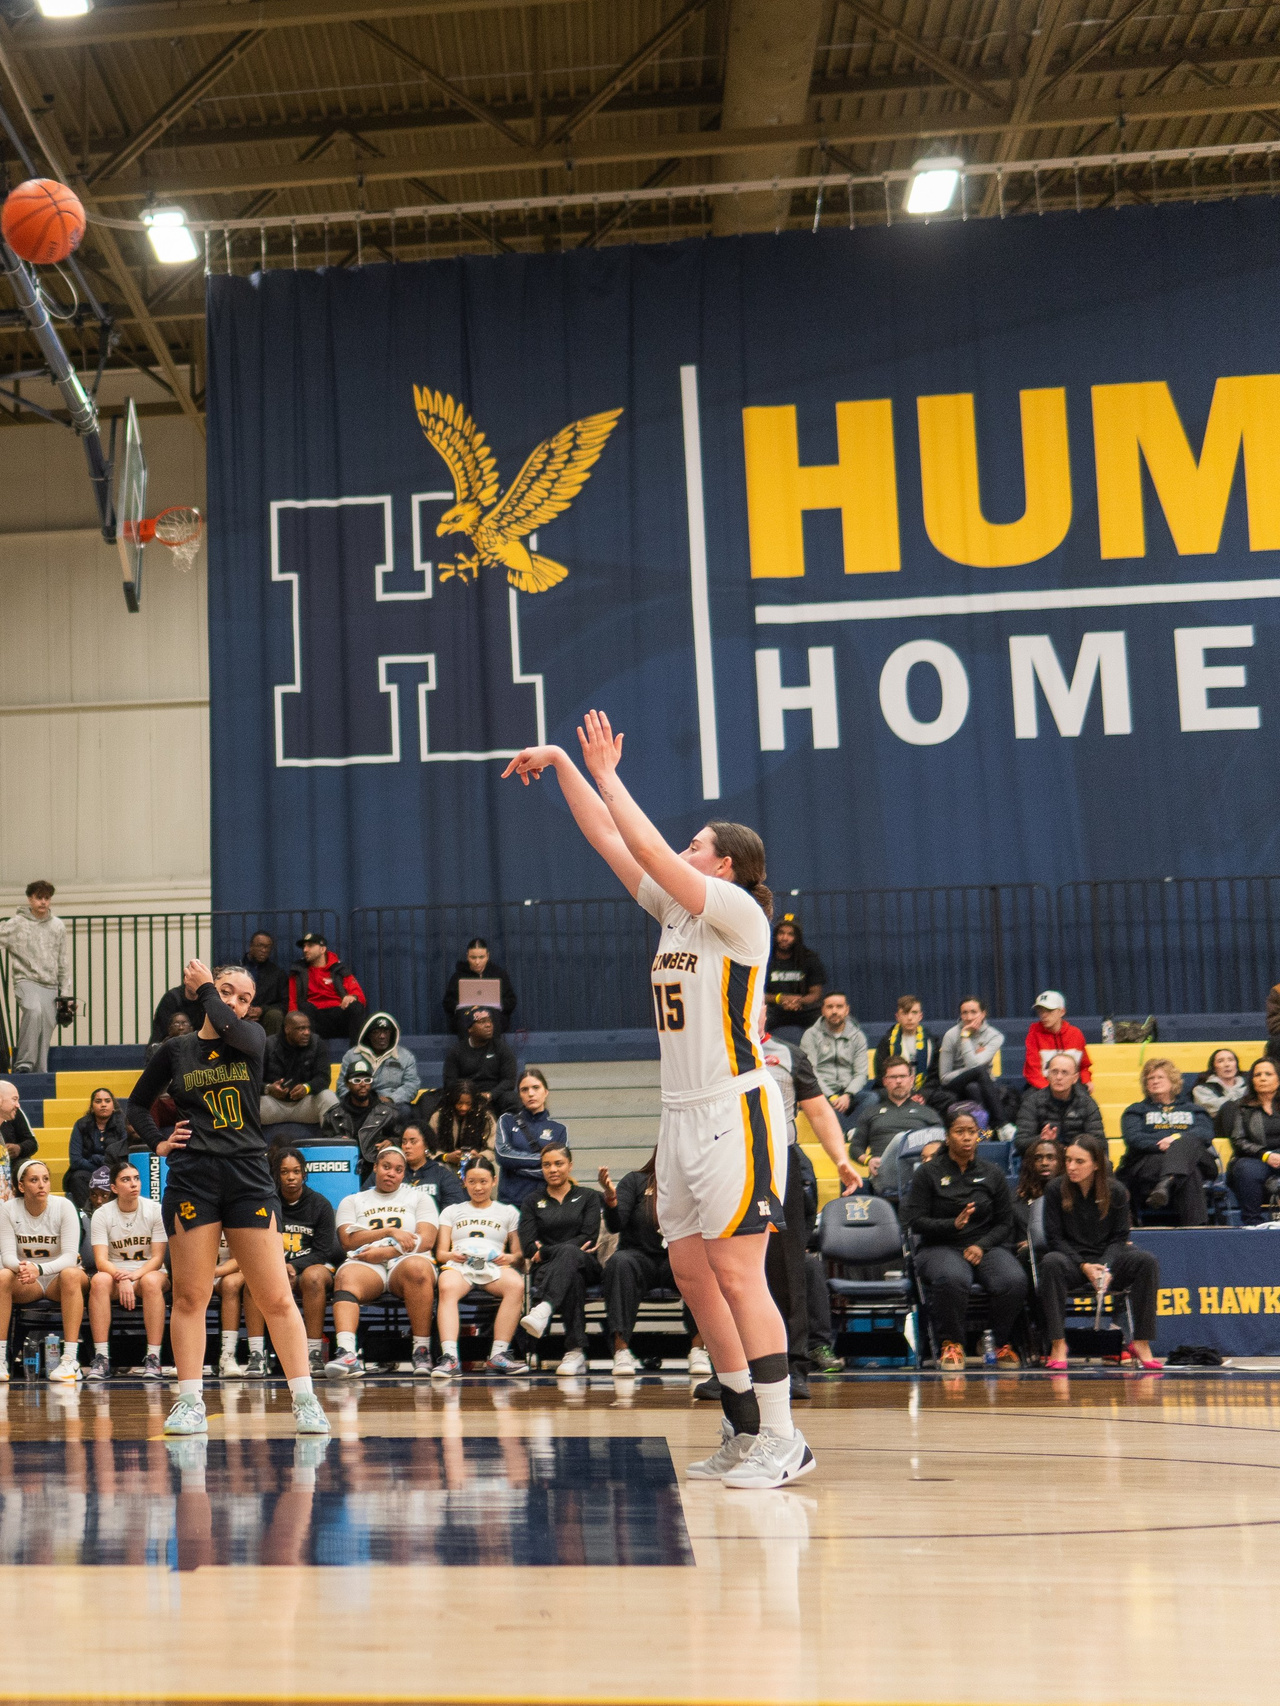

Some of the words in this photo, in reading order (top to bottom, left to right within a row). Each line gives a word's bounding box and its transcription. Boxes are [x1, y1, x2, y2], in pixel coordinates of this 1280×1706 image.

[755, 624, 1262, 752] HOME
[652, 982, 685, 1032] 15
[203, 1086, 244, 1130] 10
[363, 1205, 407, 1218] HUMBER
[455, 1219, 502, 1232] HUMBER
[17, 1235, 58, 1245] HUMBER
[110, 1236, 152, 1250] HUMBER
[1156, 1287, 1192, 1315] ER
[1198, 1286, 1280, 1314] HAWK
